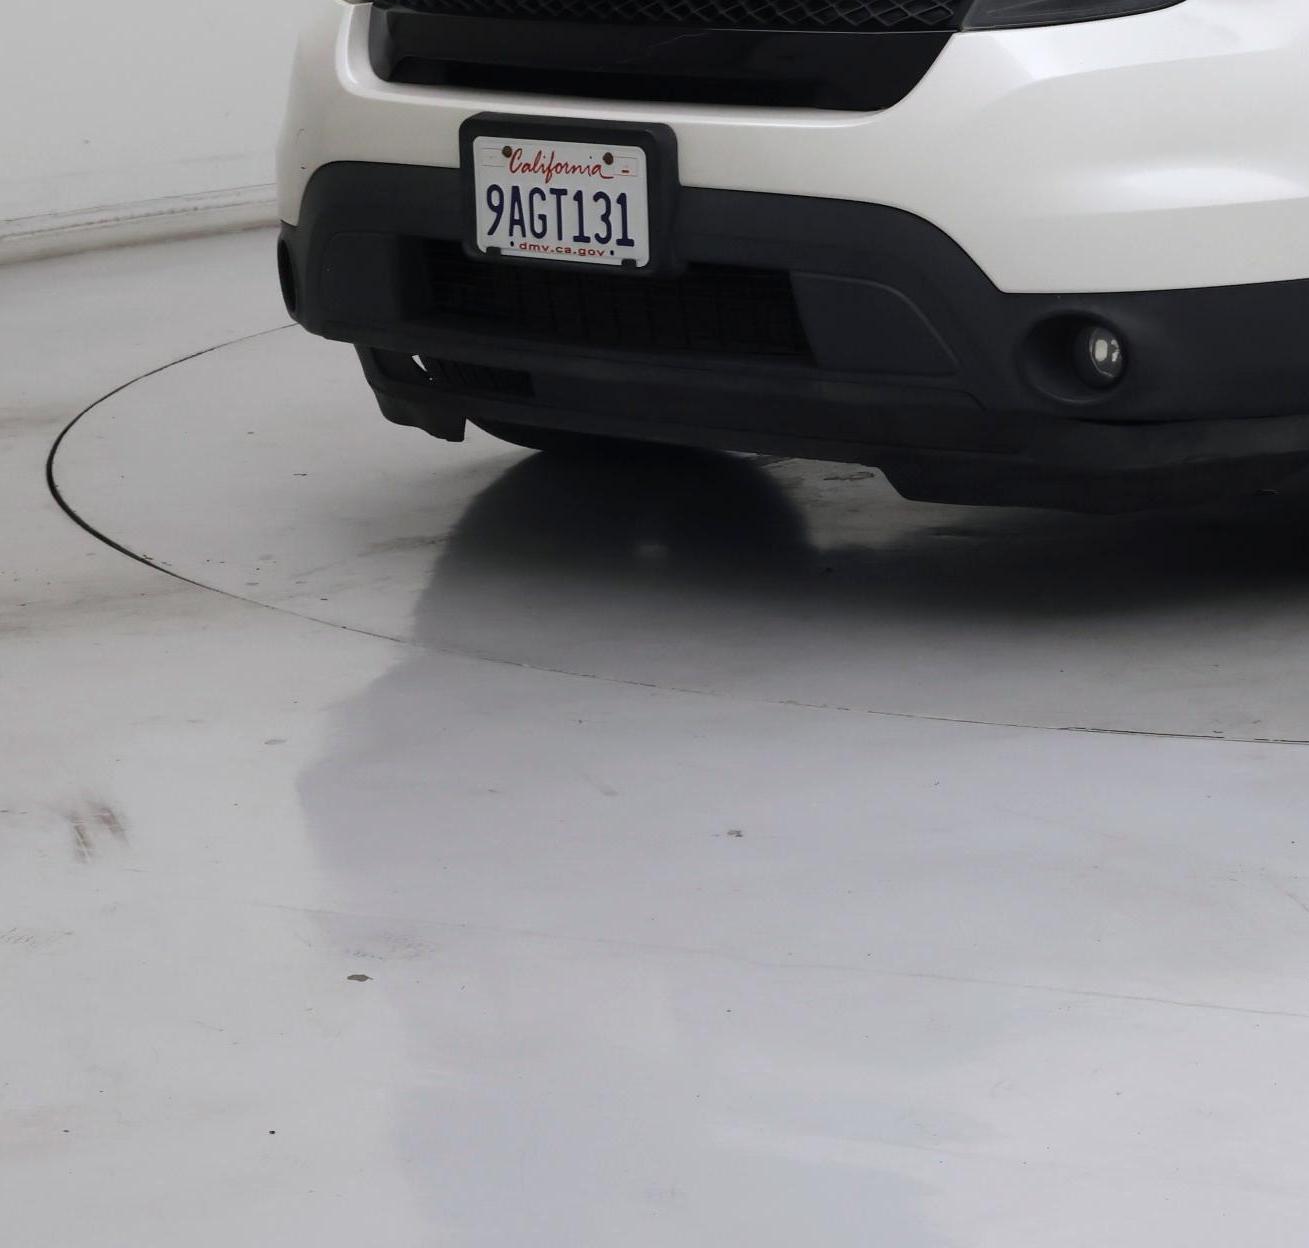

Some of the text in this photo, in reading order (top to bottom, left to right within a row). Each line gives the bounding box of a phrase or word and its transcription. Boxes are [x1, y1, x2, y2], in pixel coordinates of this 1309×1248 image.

[509, 148, 613, 183] California
[486, 184, 635, 247] 9AGT131
[518, 241, 606, 257] dmv.ca.gov
